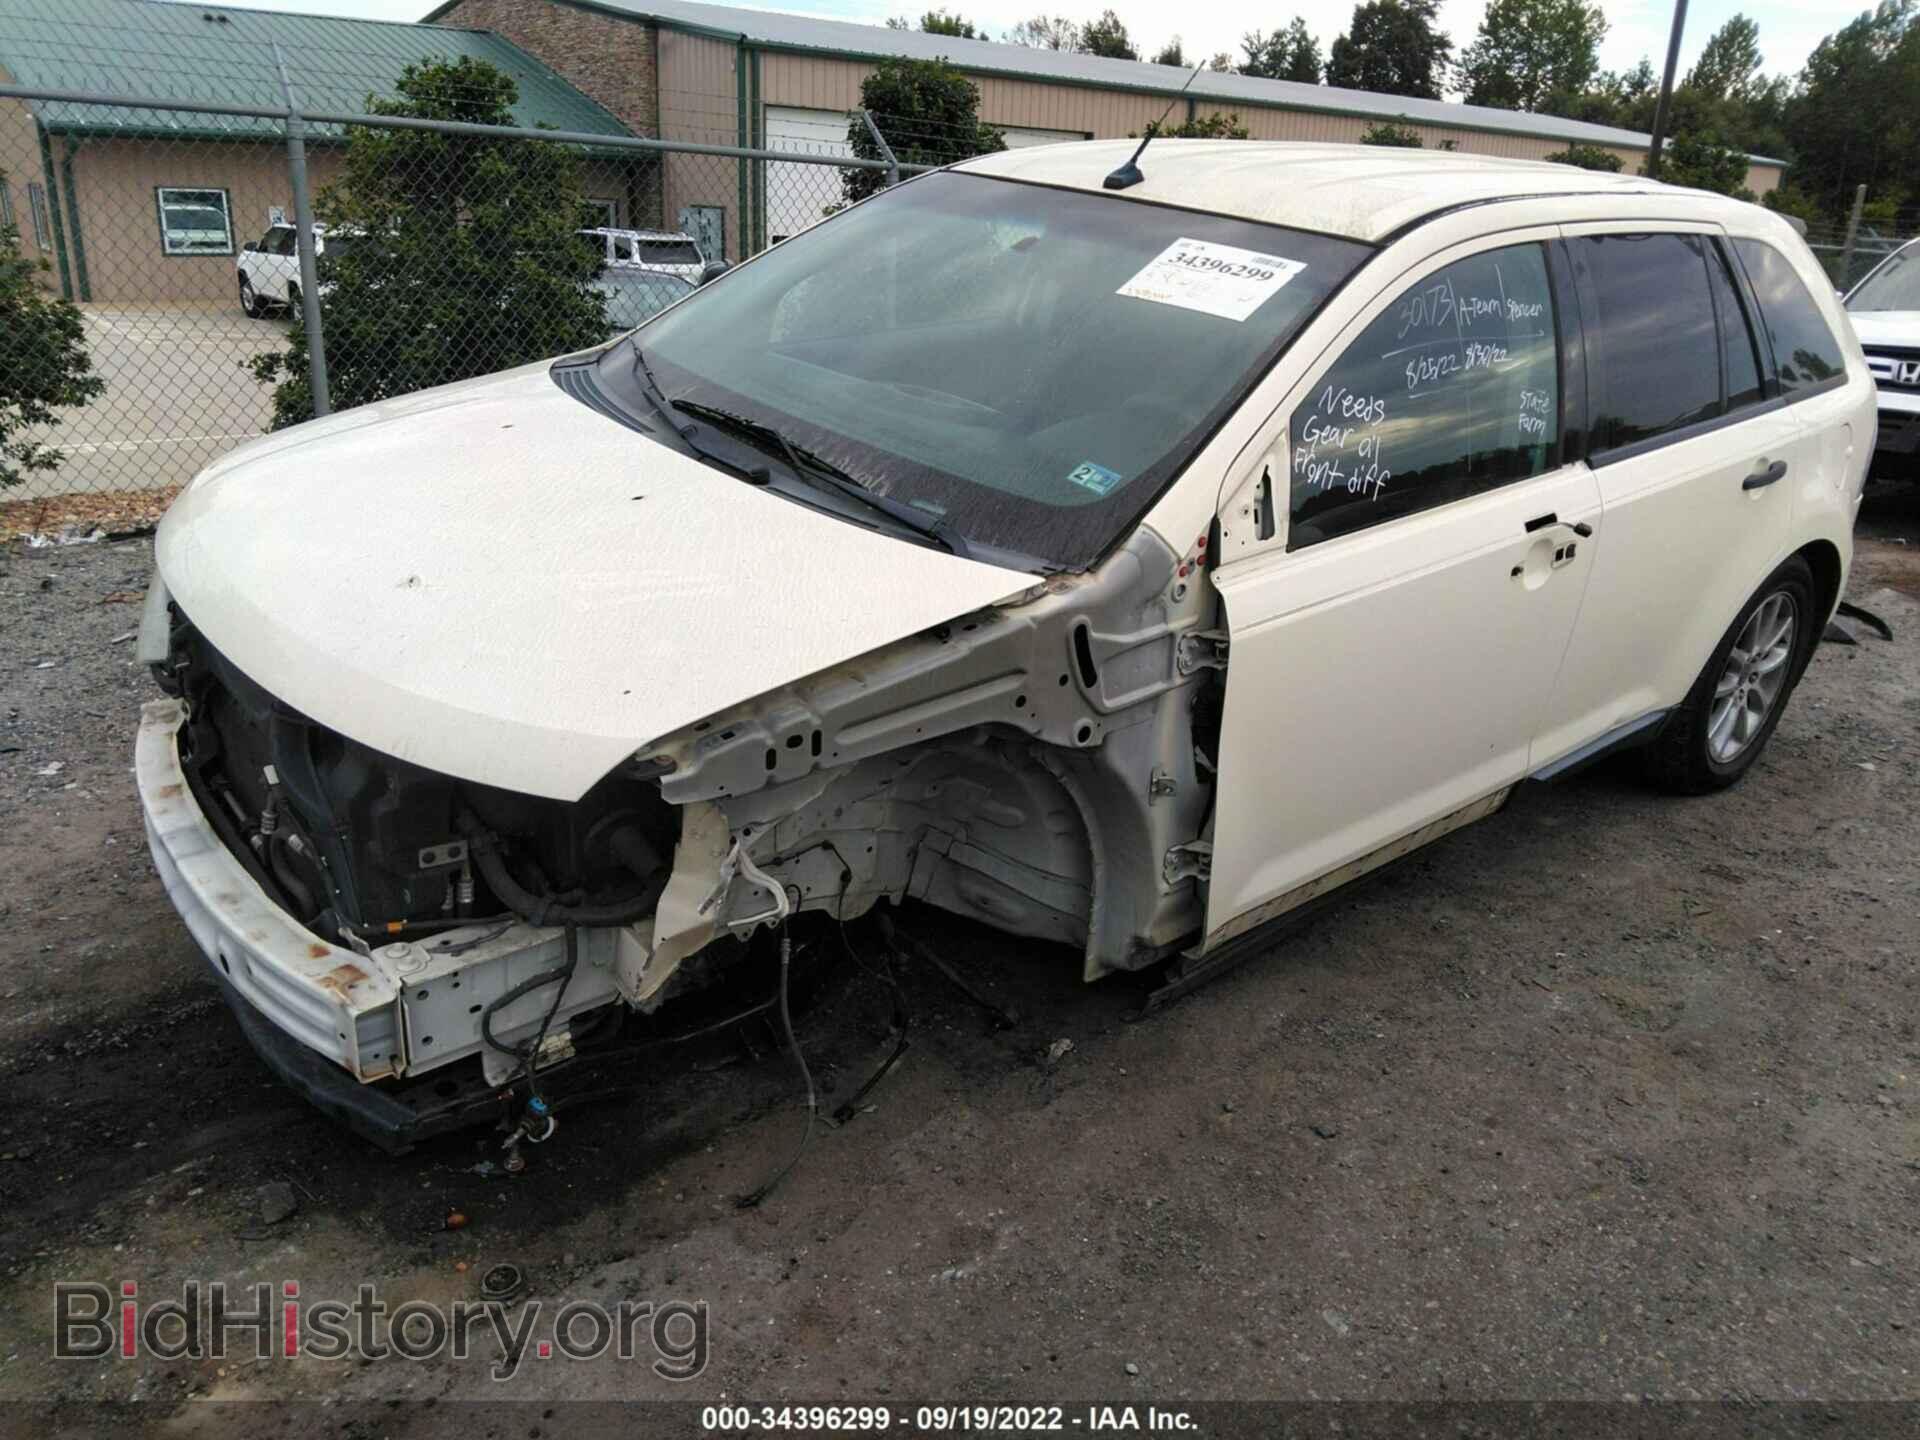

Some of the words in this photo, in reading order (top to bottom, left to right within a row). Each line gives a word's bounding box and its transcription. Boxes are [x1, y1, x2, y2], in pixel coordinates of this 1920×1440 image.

[1168, 252, 1275, 282] 34396299
[1398, 284, 1451, 339] 30173
[1318, 385, 1385, 426] Needs
[1303, 415, 1354, 453] Gear
[1295, 447, 1345, 491] Front
[1348, 463, 1391, 502] diff
